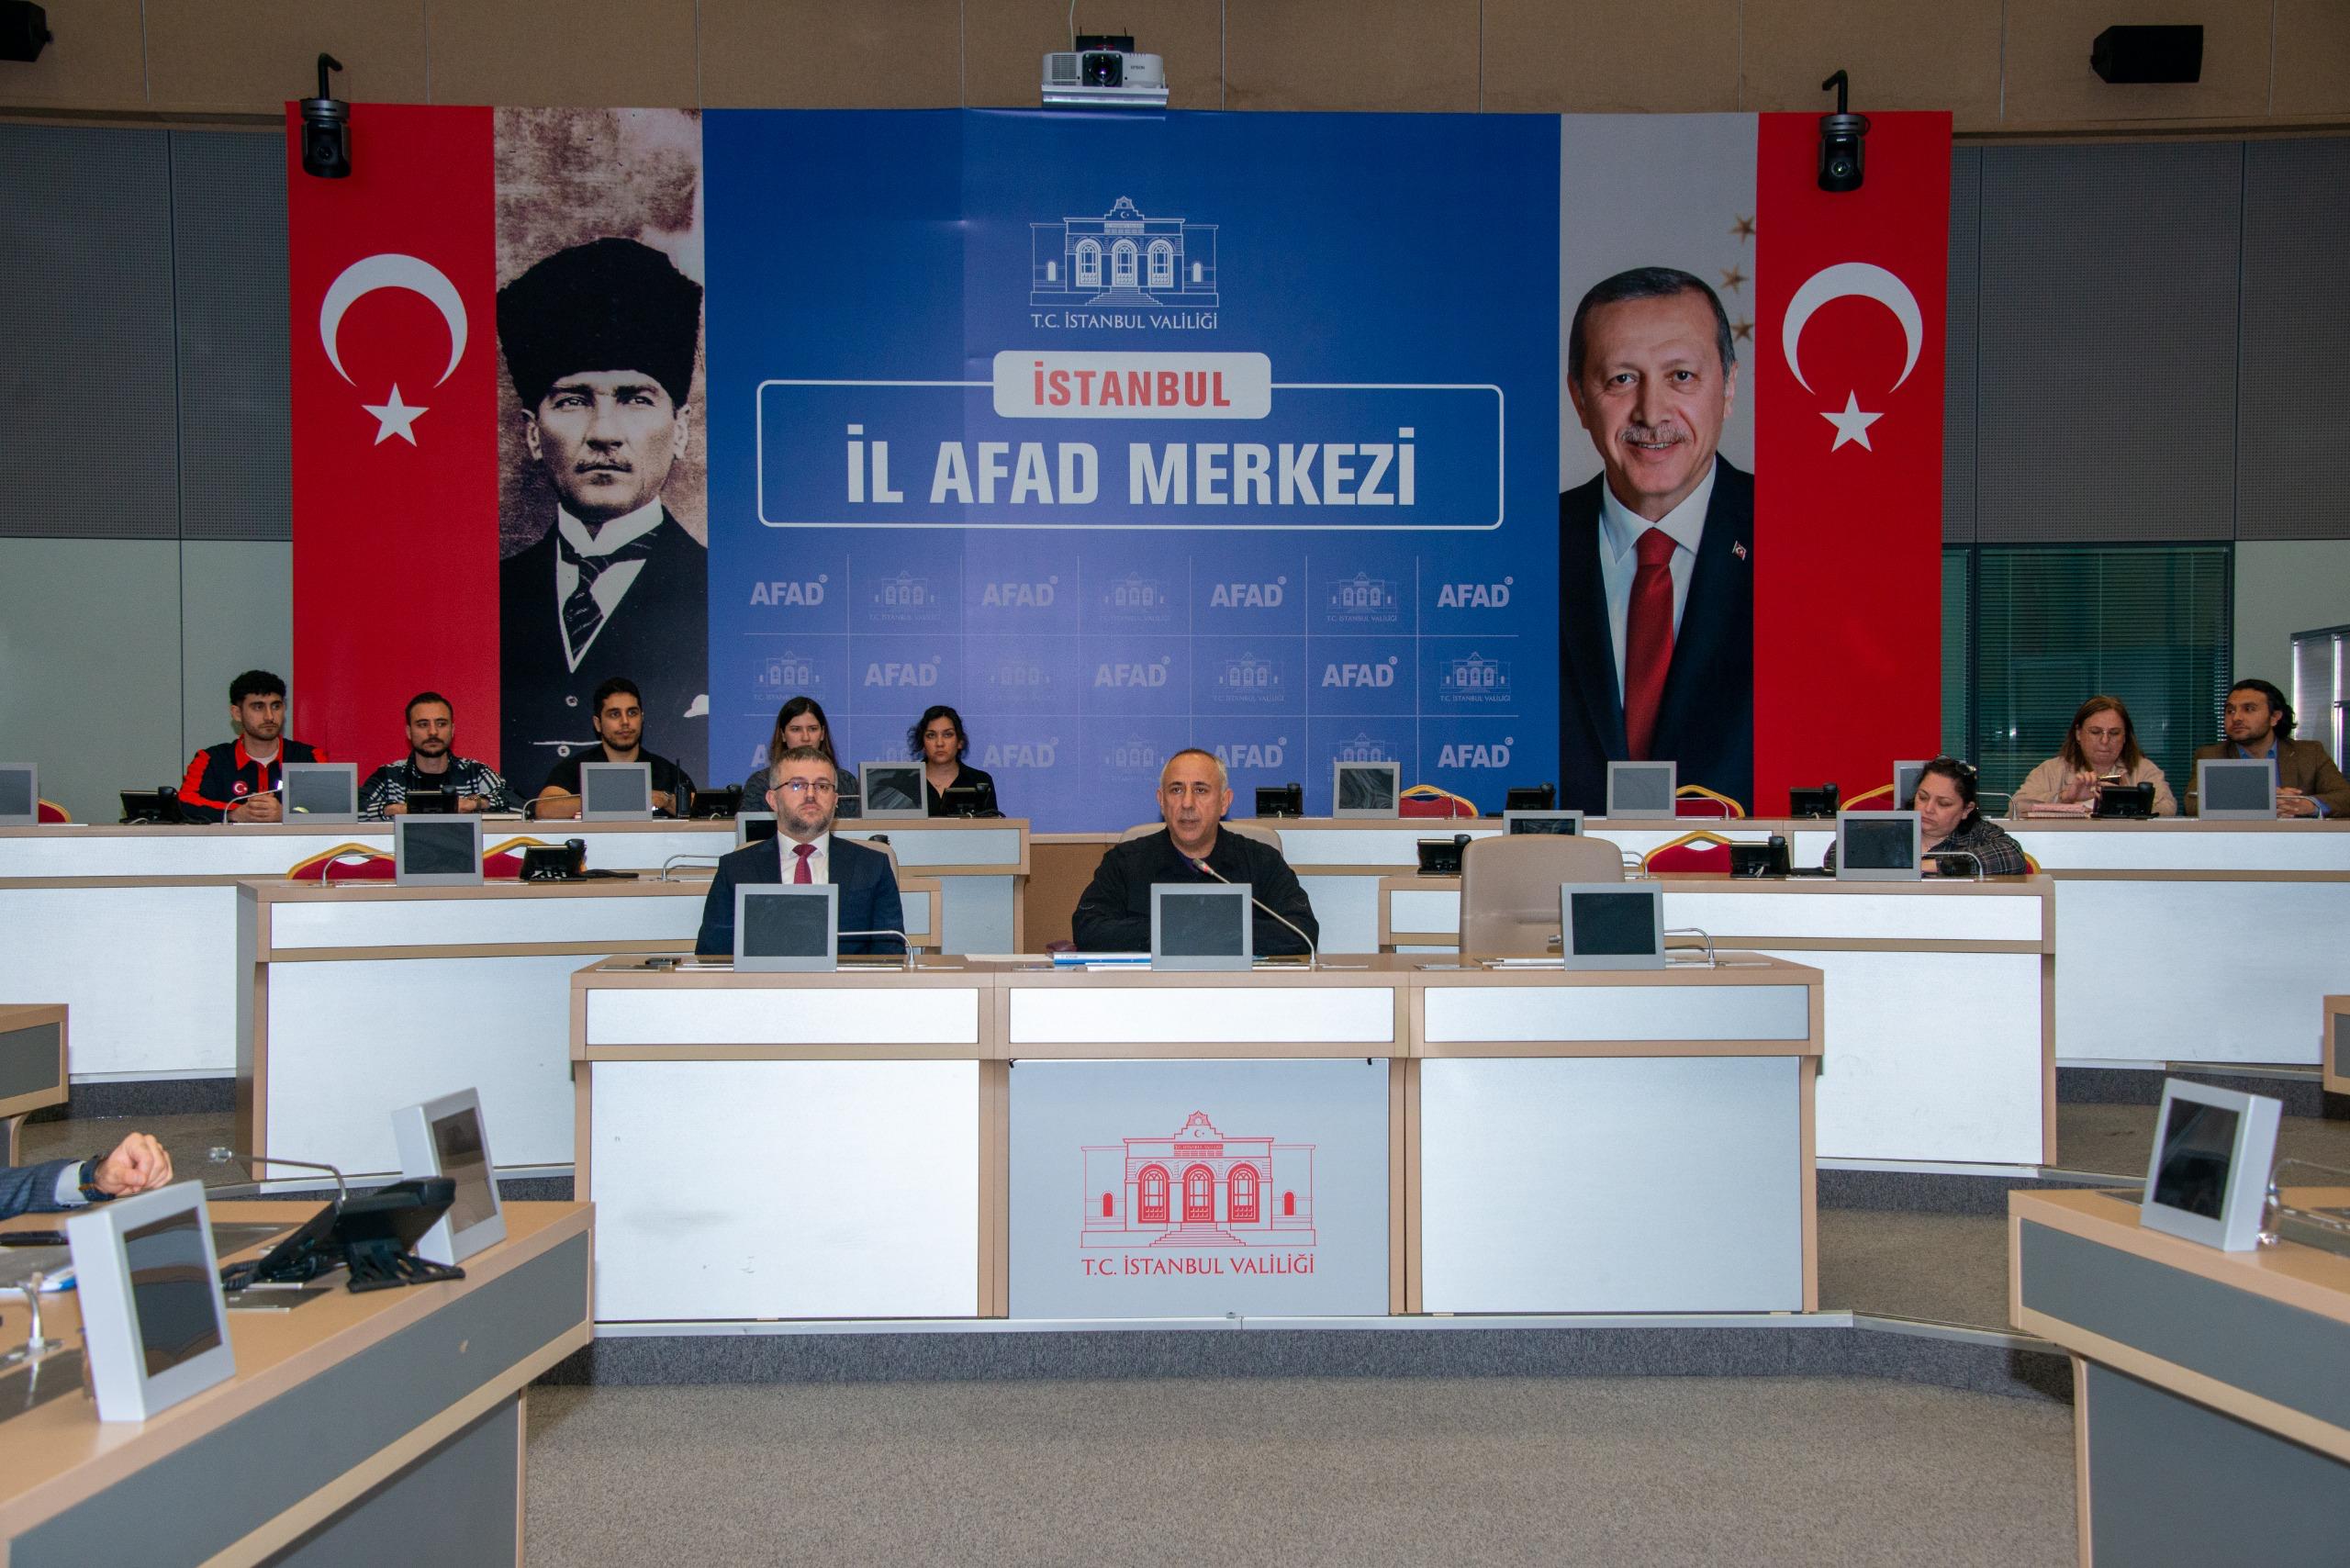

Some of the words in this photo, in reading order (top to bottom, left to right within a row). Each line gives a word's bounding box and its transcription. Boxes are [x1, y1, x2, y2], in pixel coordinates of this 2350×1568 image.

[1030, 313, 1059, 329] T.C.
[1065, 309, 1144, 329] İSTANBUL
[1148, 309, 1218, 330] VALİLİĞİ
[1034, 360, 1231, 408] İSTANBUL
[846, 423, 903, 504] İL
[929, 442, 1100, 506] AFAD
[1129, 427, 1416, 506] MERKEZİ
[749, 581, 824, 606] AFAD
[982, 583, 1055, 607] AFAD
[1210, 583, 1283, 608] AFAD
[1437, 583, 1510, 608] AFAD
[864, 662, 938, 687] AFAD
[1094, 663, 1167, 688] AFAD
[1321, 663, 1394, 688] AFAD
[983, 744, 1056, 768] AFAD
[1438, 745, 1510, 768] AFAD
[1081, 1259, 1117, 1275] T.C.
[1124, 1254, 1224, 1275] İSTANBUL
[1229, 1253, 1315, 1275] VALİLİĞİ
